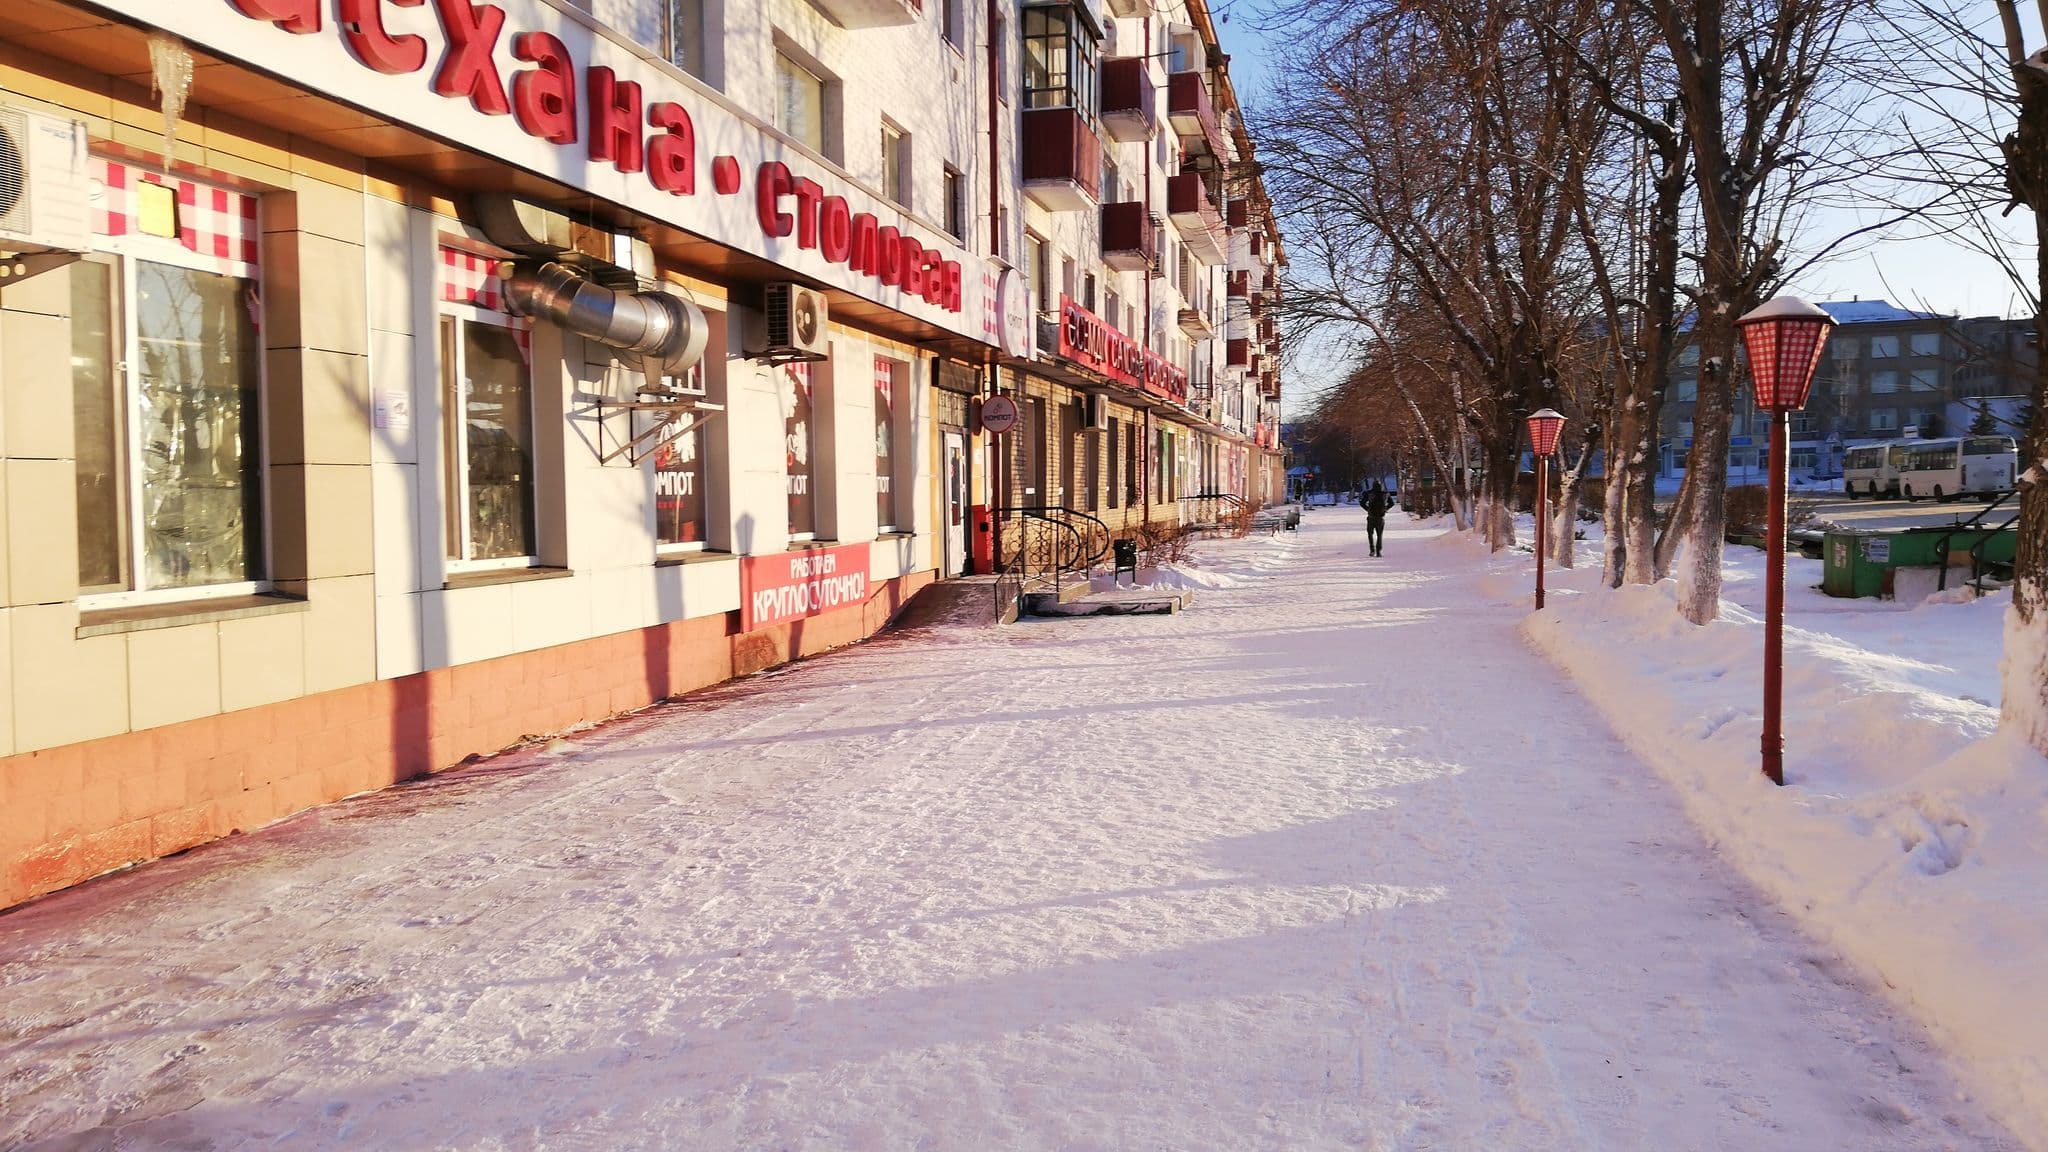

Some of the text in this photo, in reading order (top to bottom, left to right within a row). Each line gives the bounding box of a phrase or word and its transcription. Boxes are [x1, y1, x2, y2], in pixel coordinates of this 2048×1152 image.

[224, 0, 962, 313] схана столовая
[791, 554, 836, 579] РАБОТАЕМ
[753, 571, 864, 624] КРУГЛОСУТОЧНО!
